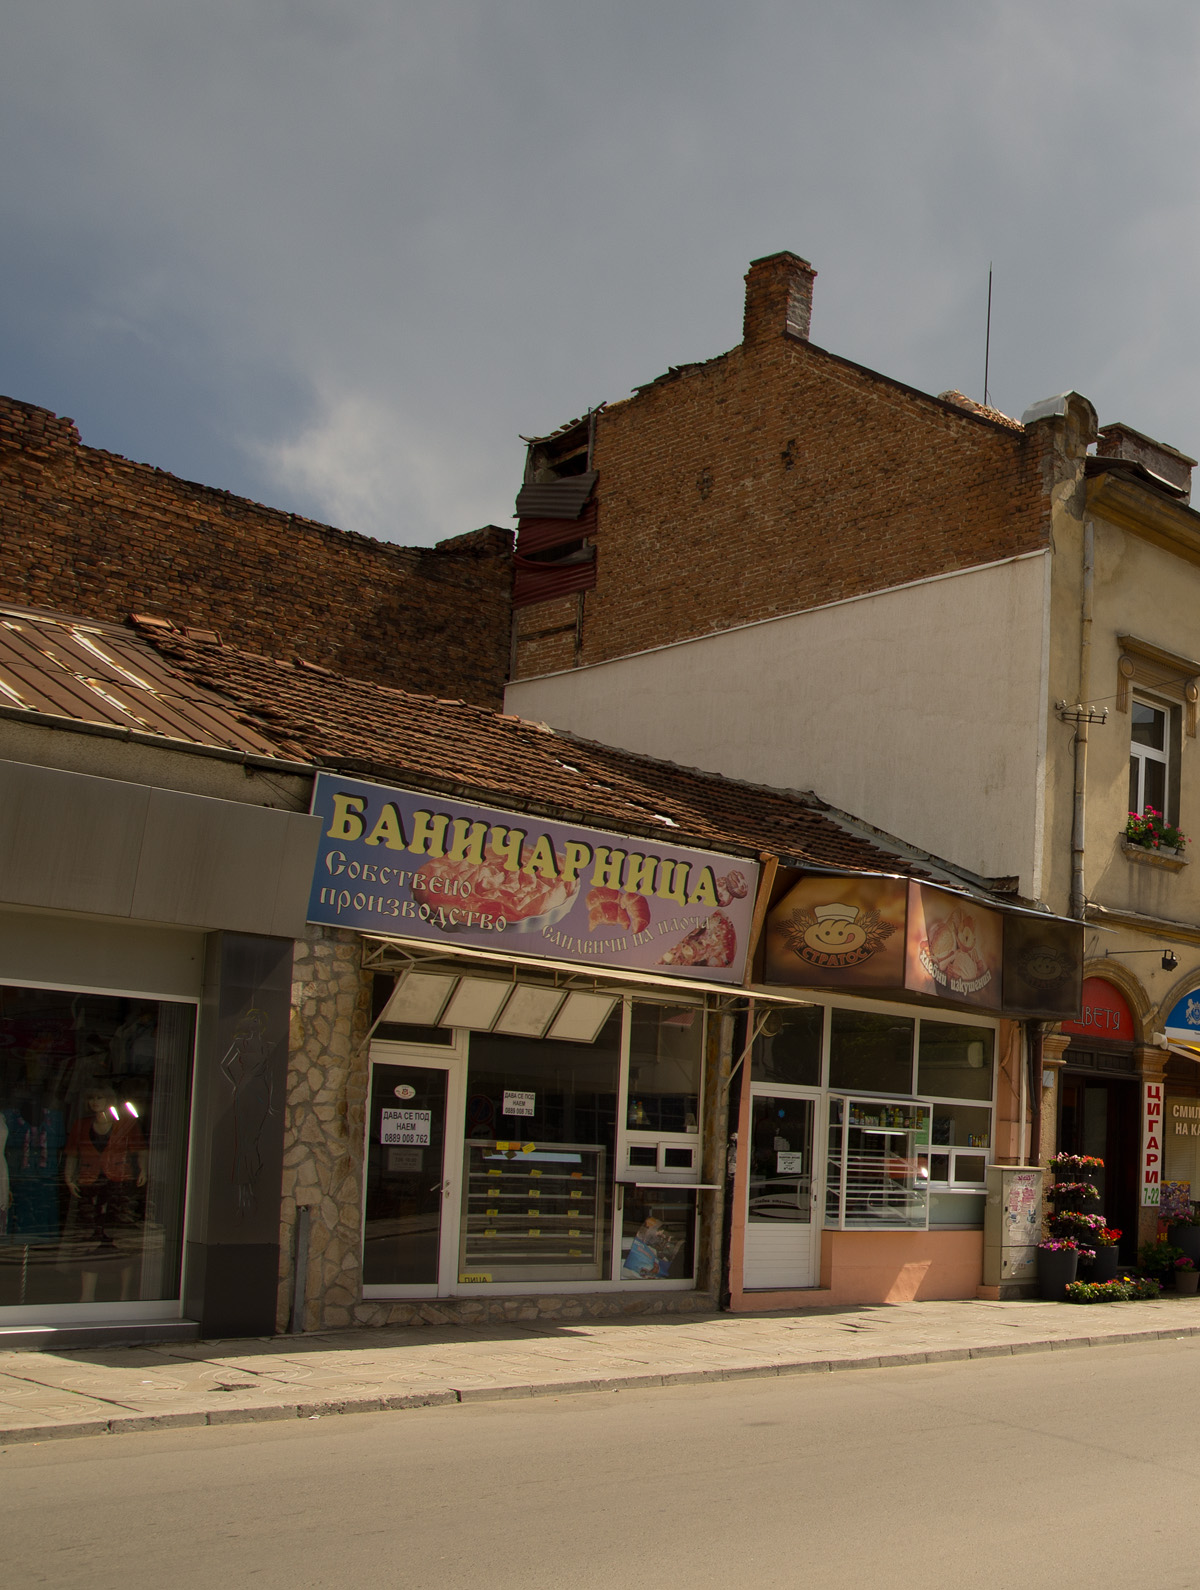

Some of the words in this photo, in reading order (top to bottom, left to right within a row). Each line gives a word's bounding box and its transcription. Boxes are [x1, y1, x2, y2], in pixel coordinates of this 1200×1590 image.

[326, 792, 720, 907] БАНИЧАРНИЦА
[325, 850, 472, 898] Собствено
[802, 948, 869, 967] СТРАТОС
[383, 1111, 402, 1120] ДАВА
[404, 1111, 413, 1120] СЕ
[415, 1112, 430, 1122] ПОД
[396, 1123, 416, 1131] НАЕМ
[1145, 1085, 1161, 1184] ЦИГАРИ
[1175, 1122, 1188, 1135] НА
[385, 1133, 401, 1142] 0889
[416, 1134, 428, 1143] 762
[1143, 1187, 1159, 1205] 7-22
